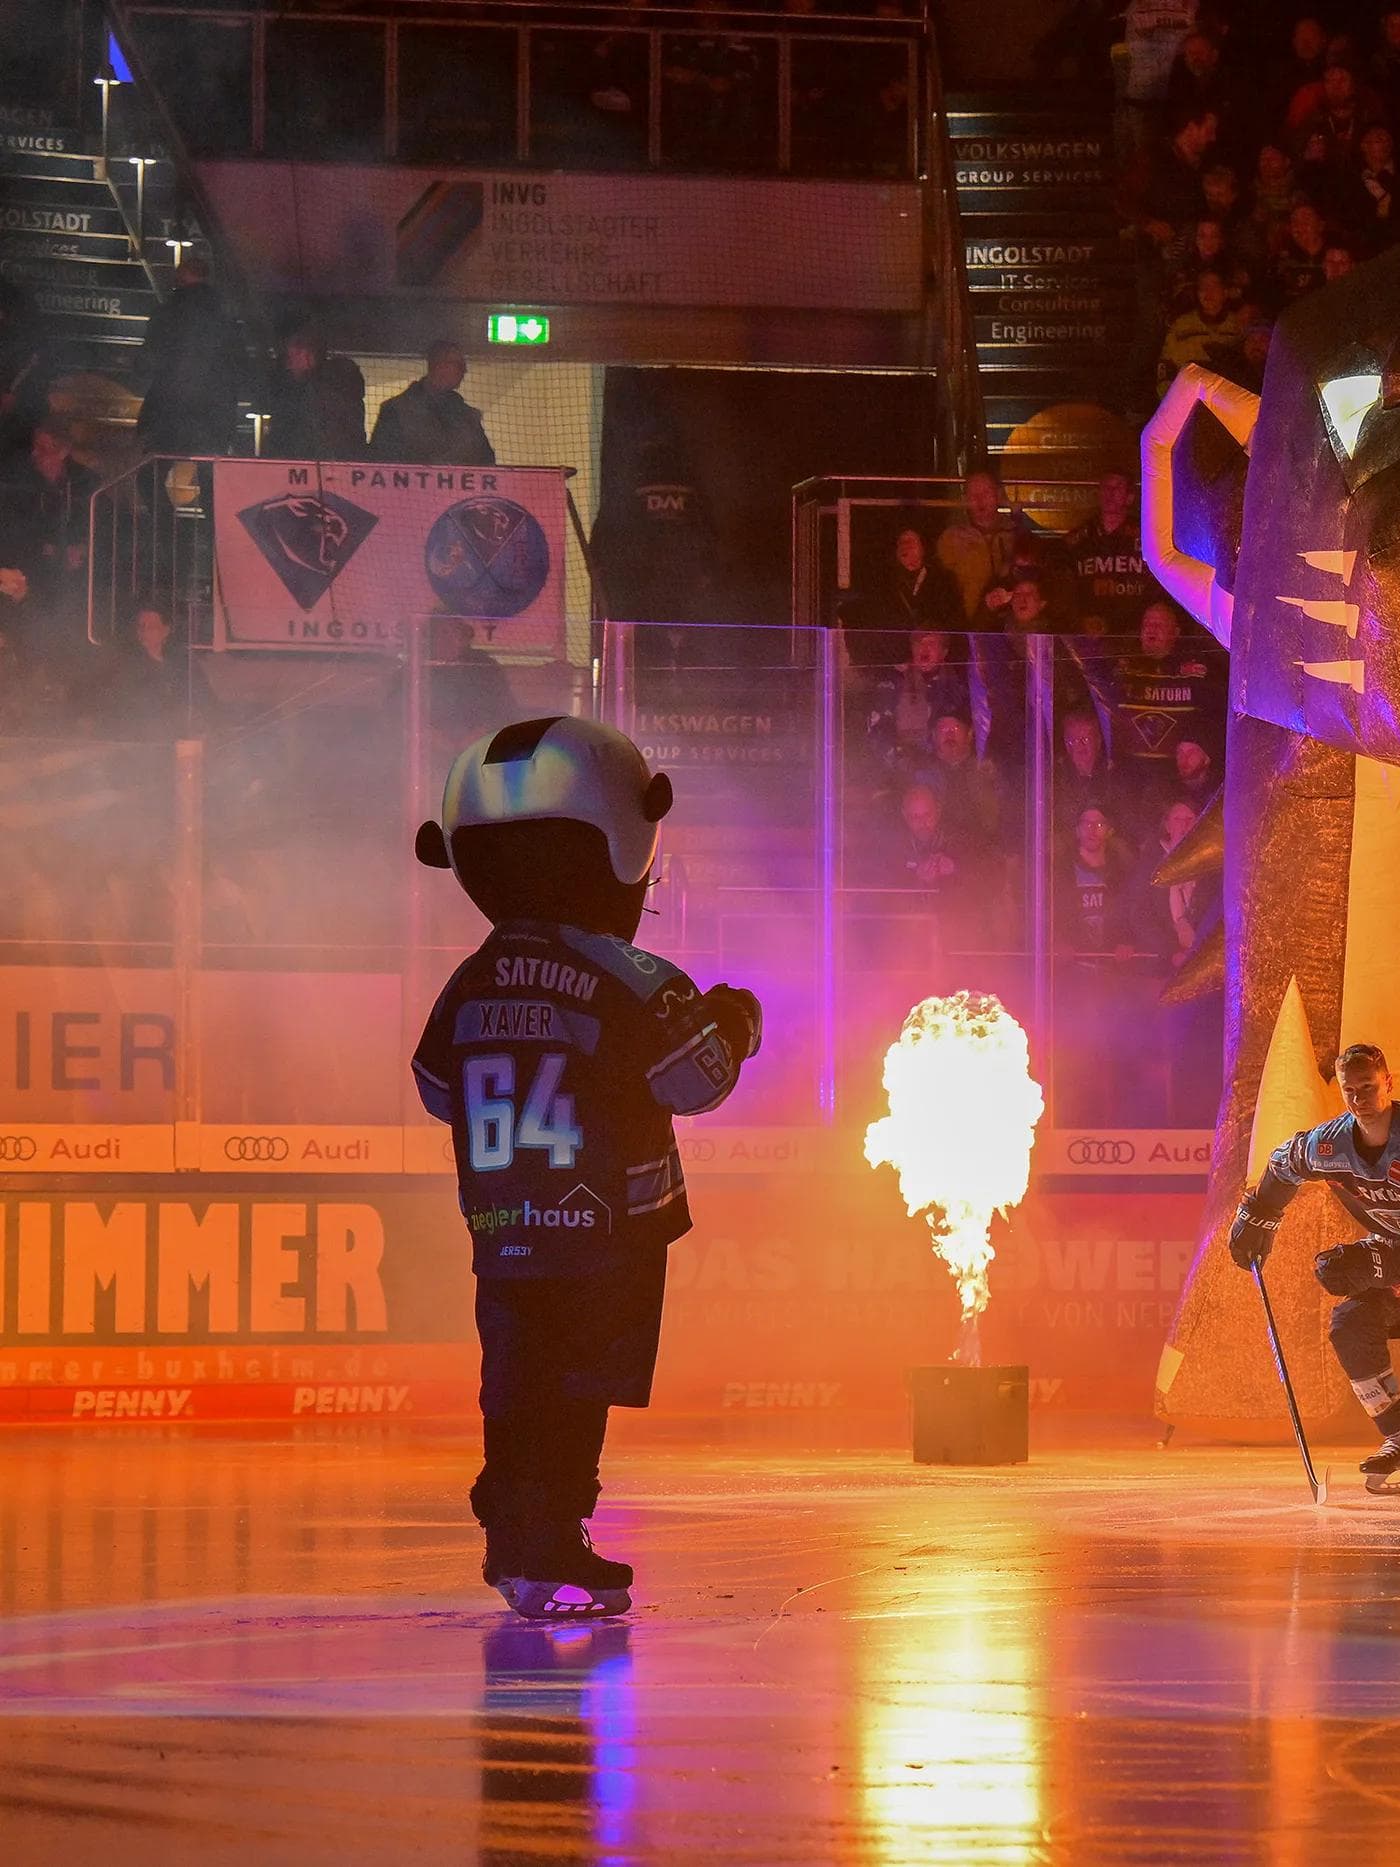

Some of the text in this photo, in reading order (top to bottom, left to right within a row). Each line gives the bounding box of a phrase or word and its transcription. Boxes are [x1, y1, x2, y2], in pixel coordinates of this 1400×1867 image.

[954, 143, 1100, 160] VOLKSWAGEN
[956, 171, 1015, 184] GROUP
[492, 183, 547, 206] INVG
[966, 245, 1094, 264] INGOLSTADT
[991, 321, 1107, 343] Engineering
[1143, 686, 1192, 702] SATURN
[494, 957, 600, 1002] SATURN
[478, 1002, 554, 1038] XAVER
[463, 1052, 584, 1173] 64
[49, 1138, 121, 1160] Audi
[301, 1138, 370, 1160] Audi
[728, 1140, 799, 1160] Audi
[471, 1200, 596, 1234] zieglerhaus
